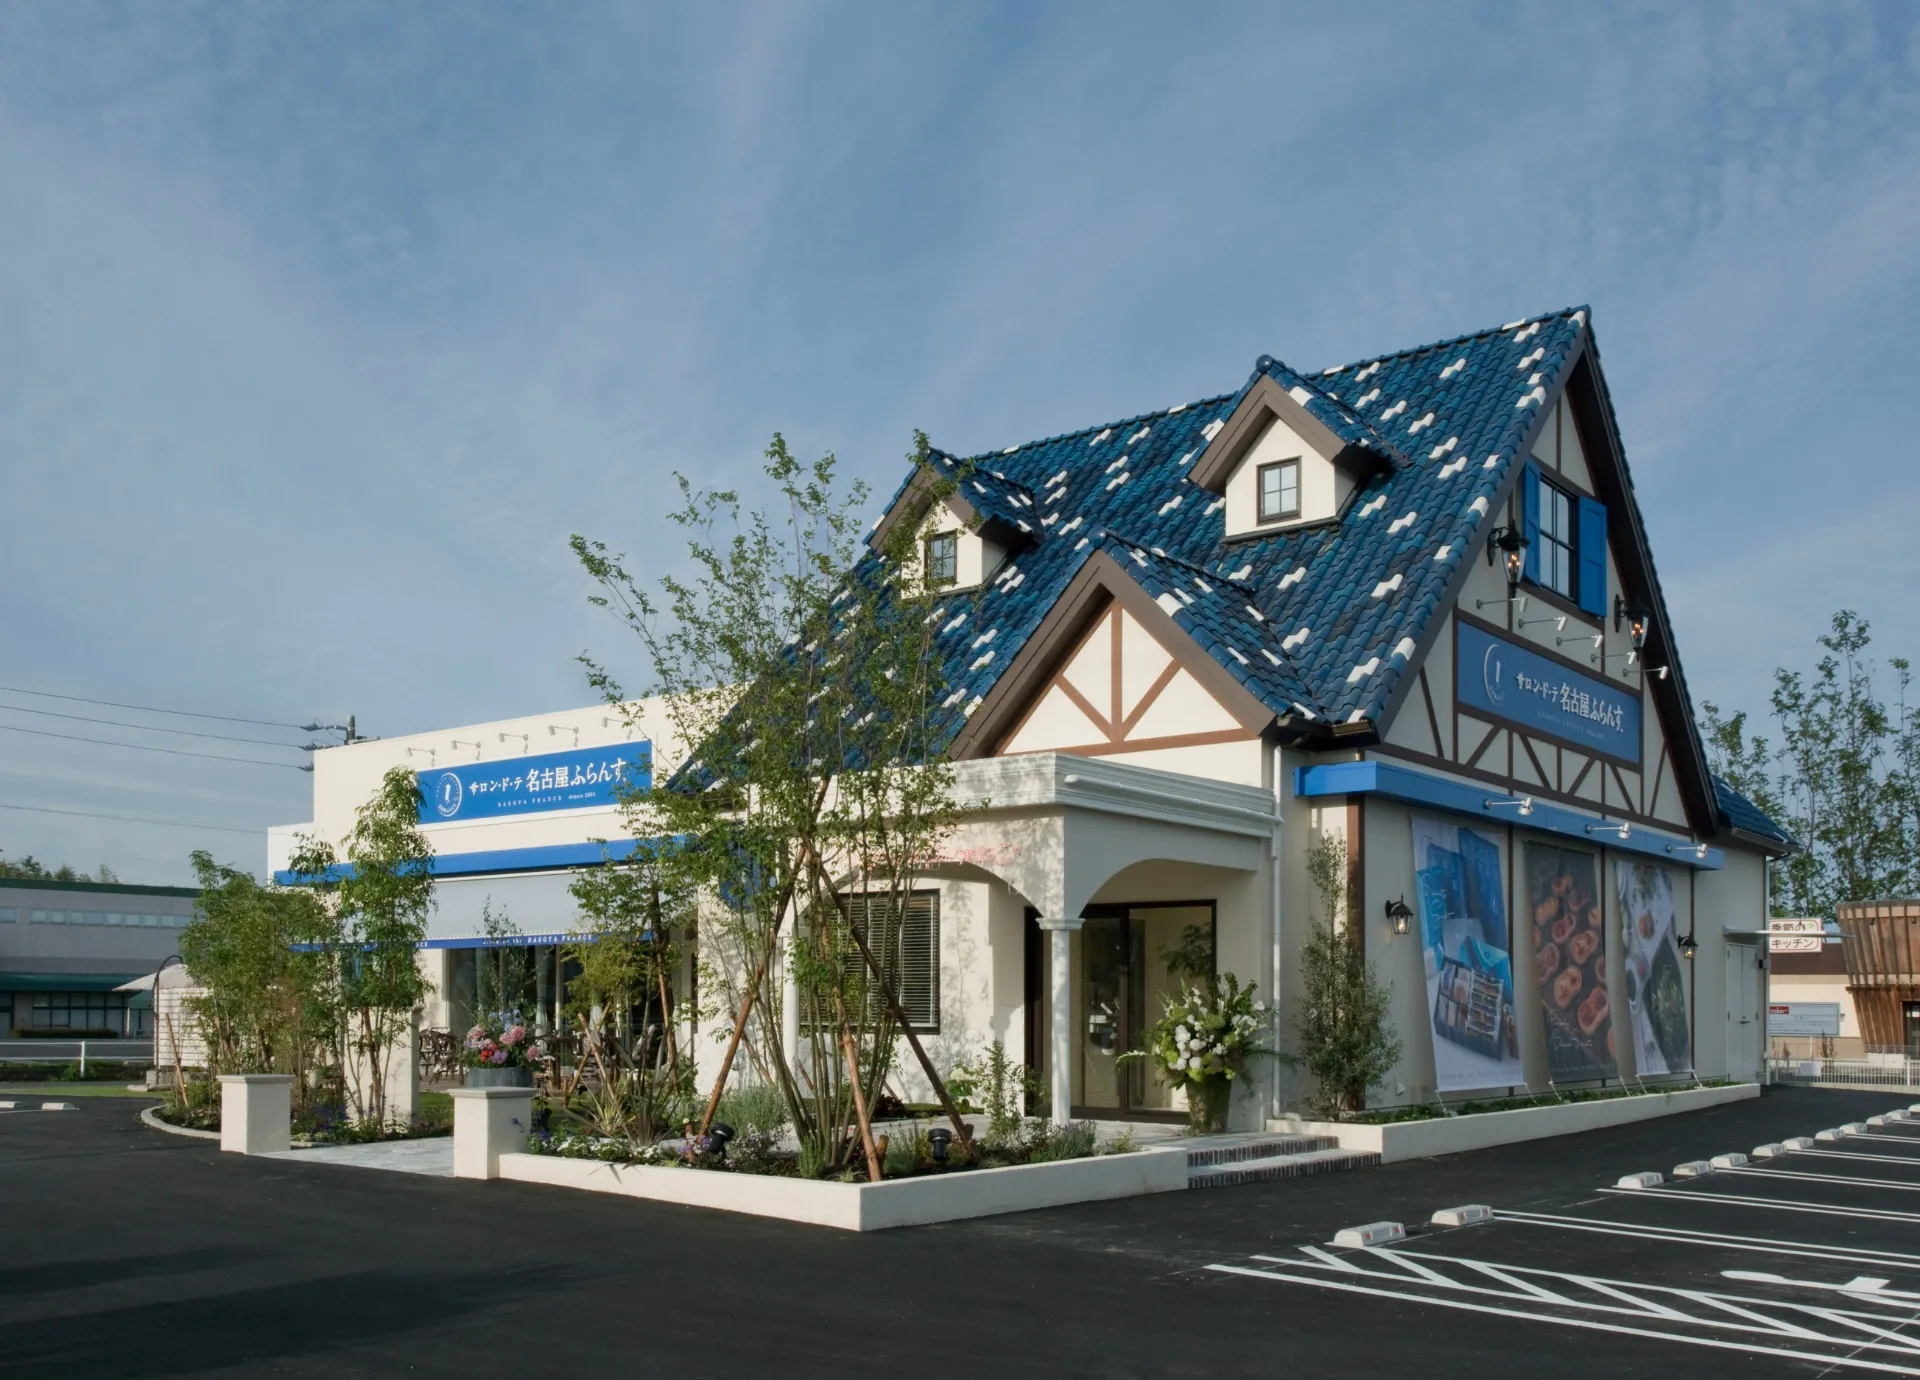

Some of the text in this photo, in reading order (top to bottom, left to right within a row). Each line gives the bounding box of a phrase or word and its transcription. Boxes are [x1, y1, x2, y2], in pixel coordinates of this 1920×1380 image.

[1515, 671, 1559, 702] サロン・ド・テ
[469, 776, 523, 796] サロン・ド・テ
[497, 798, 527, 808] NAGOYA
[532, 795, 562, 804] FRANCE
[527, 935, 558, 944] NAGOYA
[1771, 938, 1814, 949] キッチン
